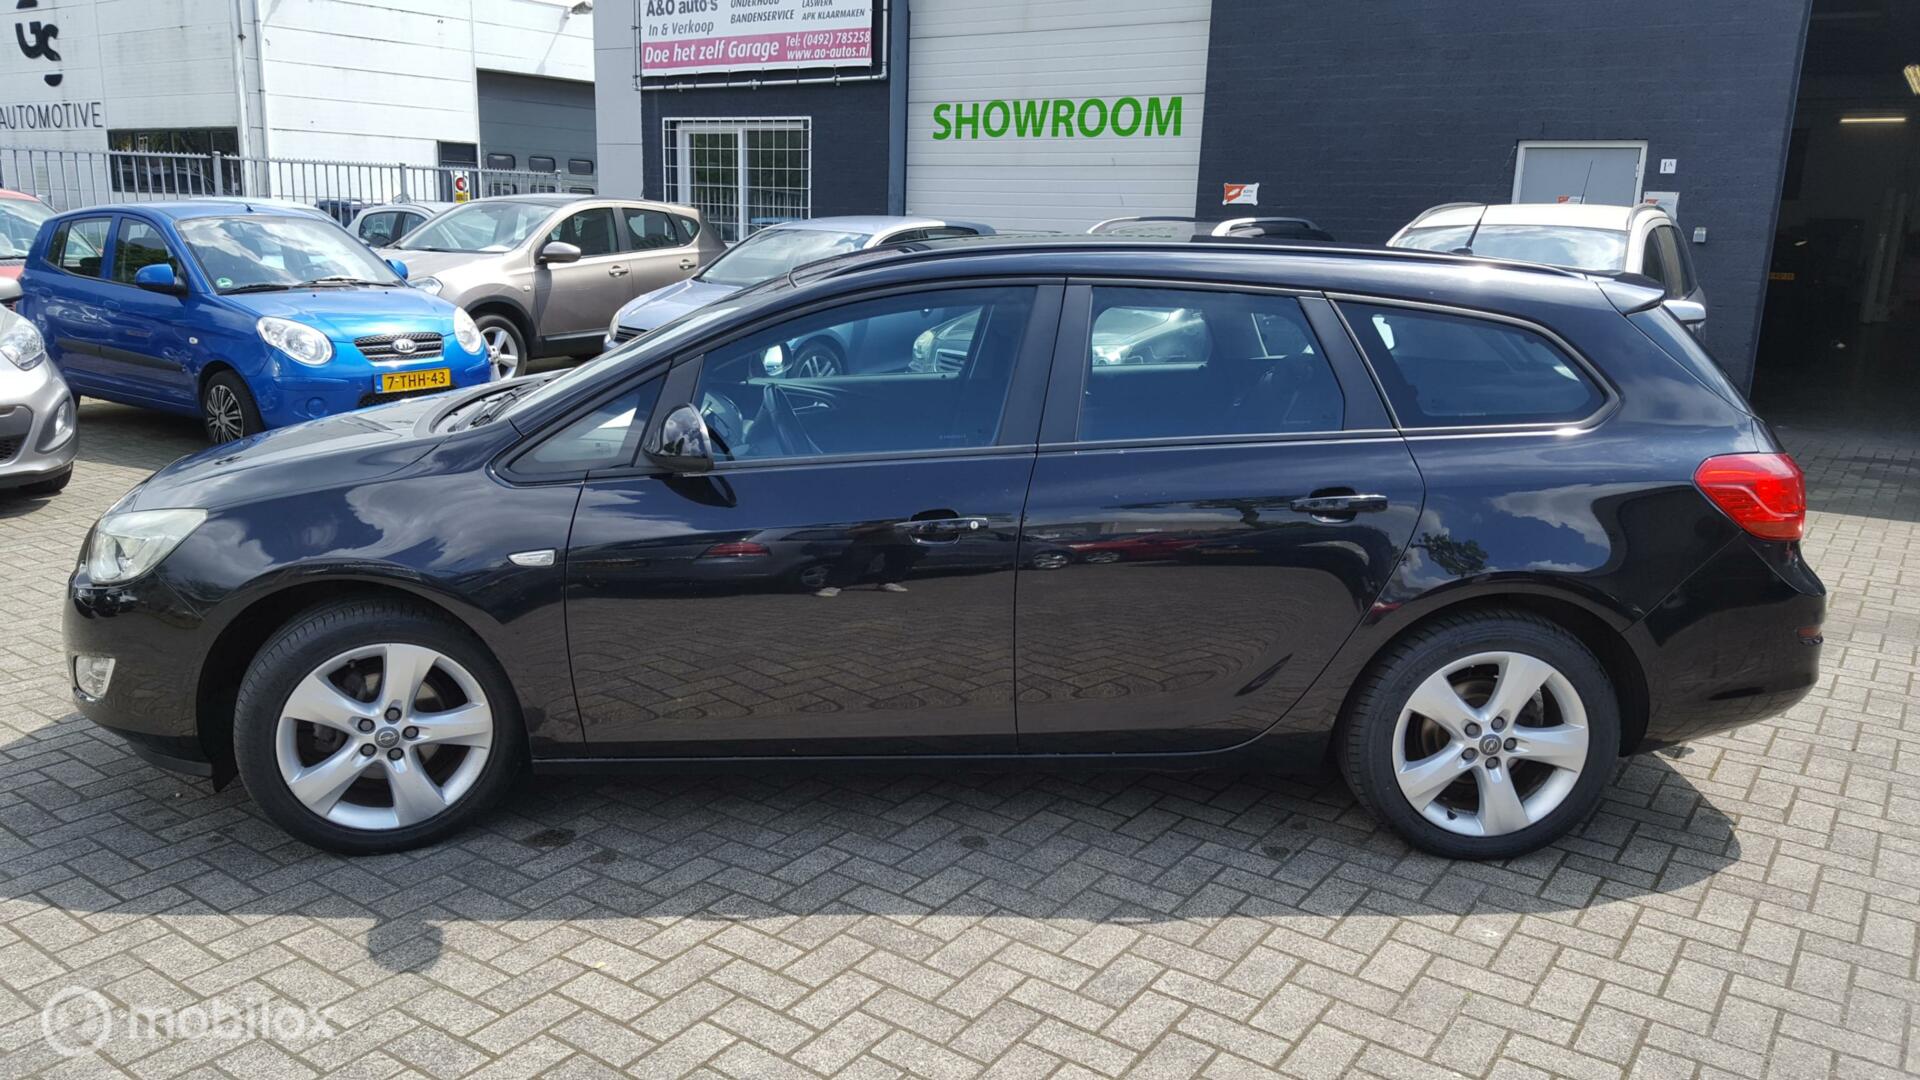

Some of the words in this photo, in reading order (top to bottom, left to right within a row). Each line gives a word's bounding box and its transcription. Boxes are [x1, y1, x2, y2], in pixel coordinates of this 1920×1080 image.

[678, 0, 718, 15] autos
[801, 12, 816, 21] APK
[817, 8, 865, 20] KLAARMAKEN
[730, 9, 795, 24] BANDENSERVICE
[648, 24, 658, 36] In
[661, 23, 669, 36] &
[672, 20, 714, 36] Verkoop
[786, 35, 800, 47] Tel:
[803, 33, 833, 48] (0492)
[836, 31, 871, 44] 785258
[645, 46, 670, 63] Doe
[673, 43, 696, 61] het
[699, 40, 725, 60] zelf
[728, 41, 779, 61] Garage
[787, 44, 870, 60] www.ao-autos.nl
[932, 96, 1182, 140] SHOWROOM
[387, 371, 446, 390] 7-THH-43
